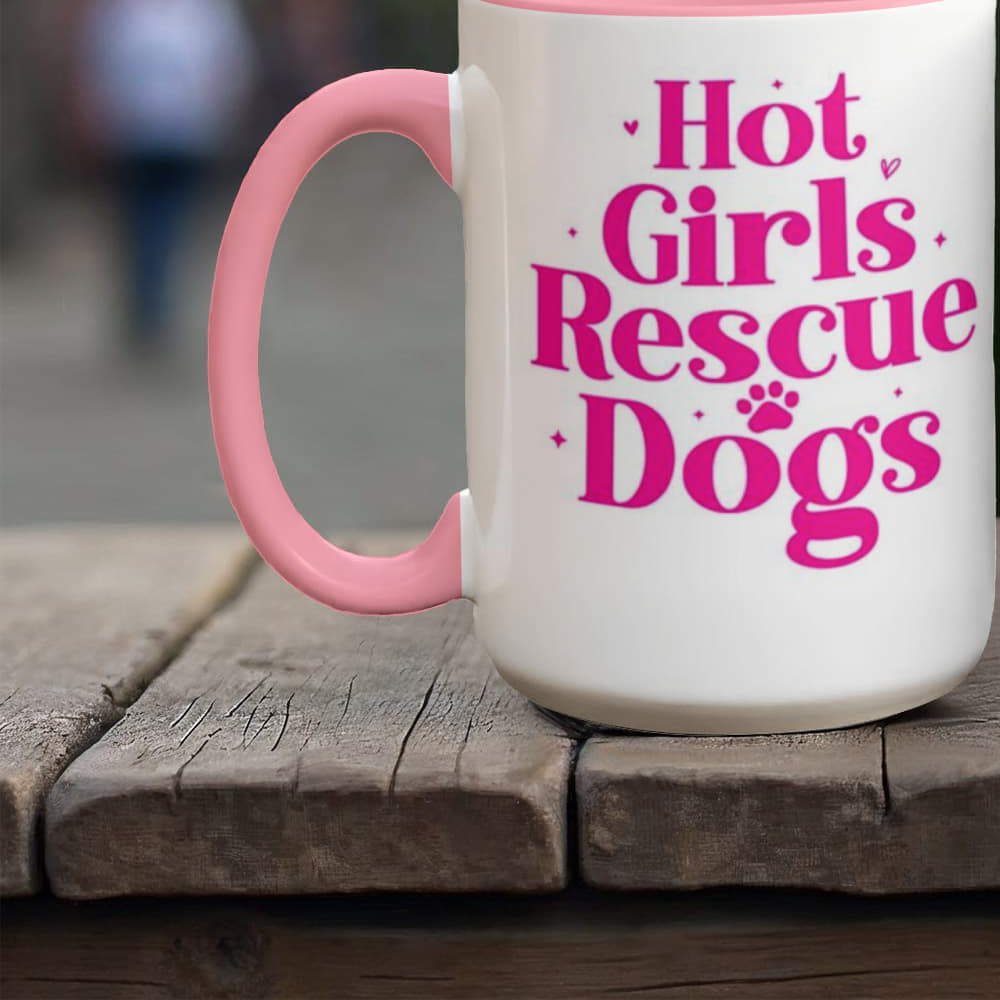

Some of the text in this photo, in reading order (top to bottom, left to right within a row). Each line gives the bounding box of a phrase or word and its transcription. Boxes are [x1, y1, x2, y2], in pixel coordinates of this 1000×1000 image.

[653, 72, 867, 171] Hot
[602, 176, 917, 287] Girls
[530, 263, 978, 385] Rescue
[577, 392, 942, 570] Dogs
